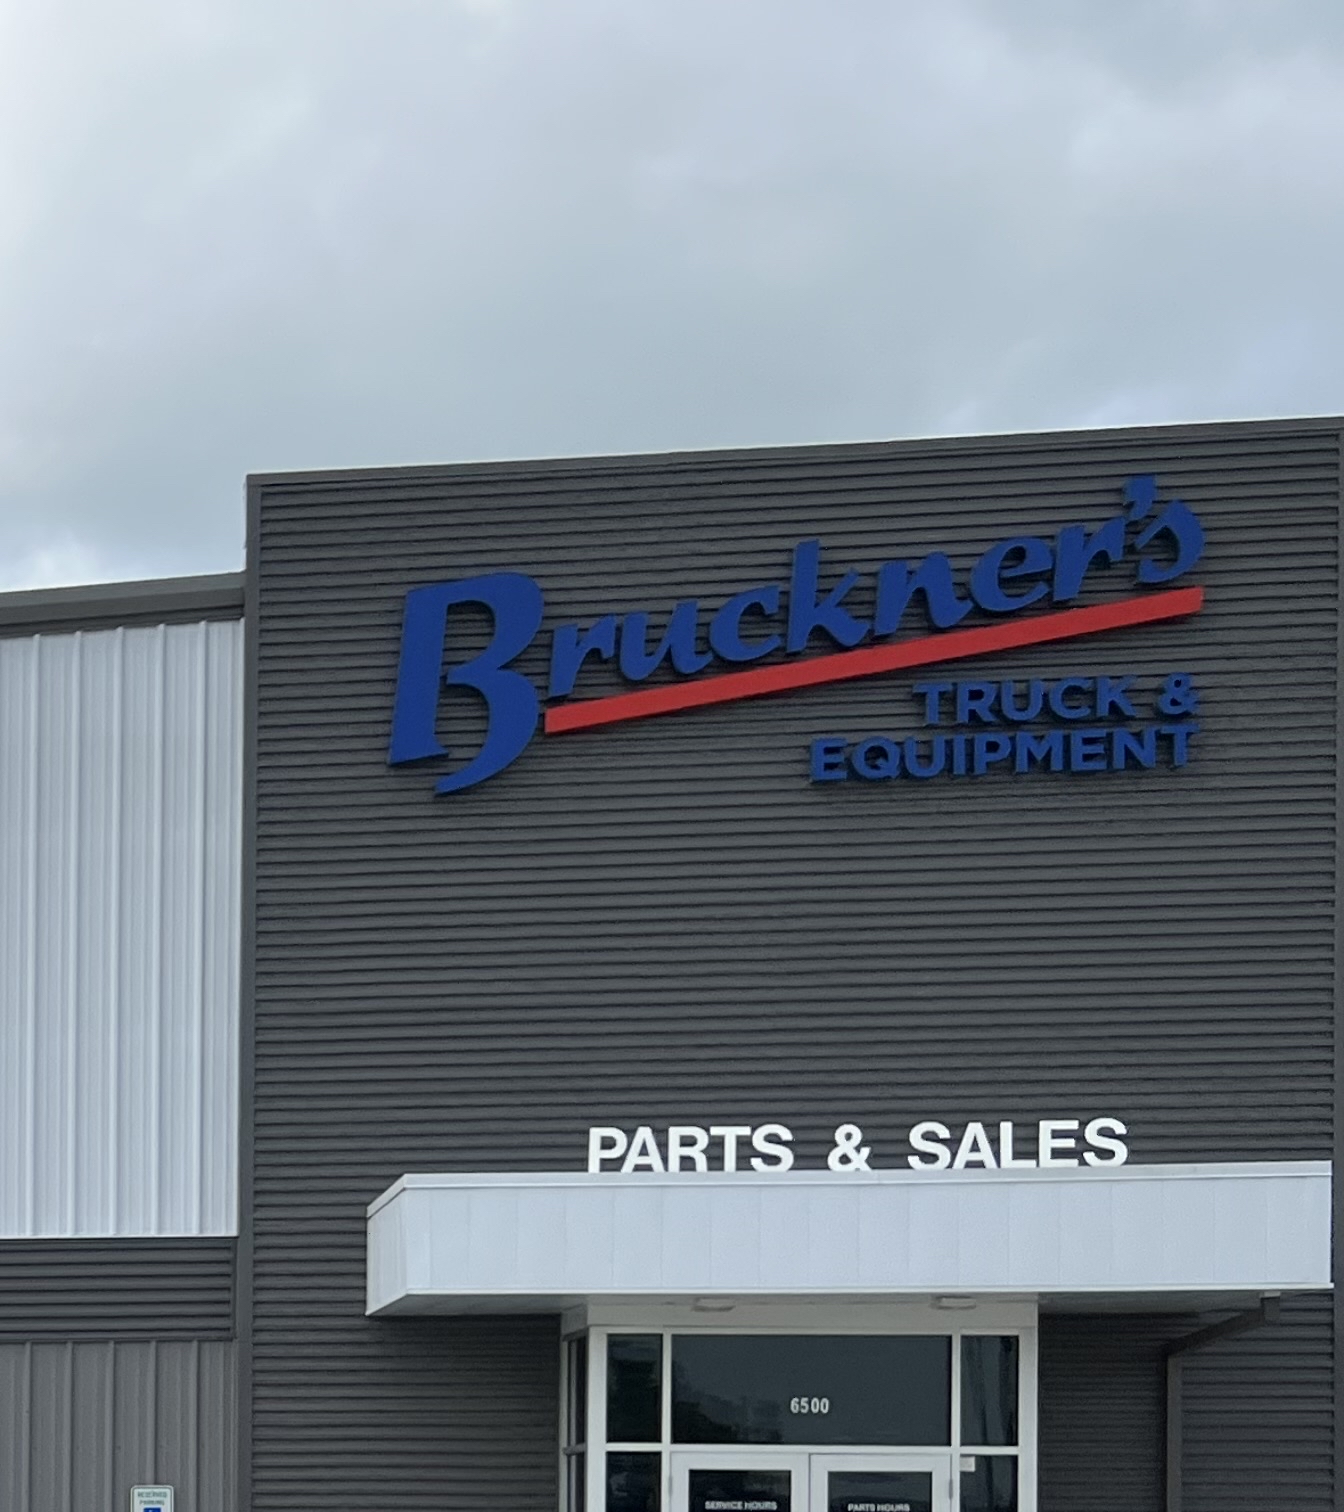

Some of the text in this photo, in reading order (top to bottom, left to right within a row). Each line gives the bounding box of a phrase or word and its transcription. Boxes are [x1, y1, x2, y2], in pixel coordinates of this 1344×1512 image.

[388, 474, 1205, 795] Bruckner's
[915, 672, 1198, 726] TRUCK &
[810, 723, 1201, 783] EQUIPMENT
[587, 1117, 1129, 1173] PARTS & SALES
[790, 1396, 829, 1414] 6500
[848, 1503, 910, 1512] PARTS HOURS
